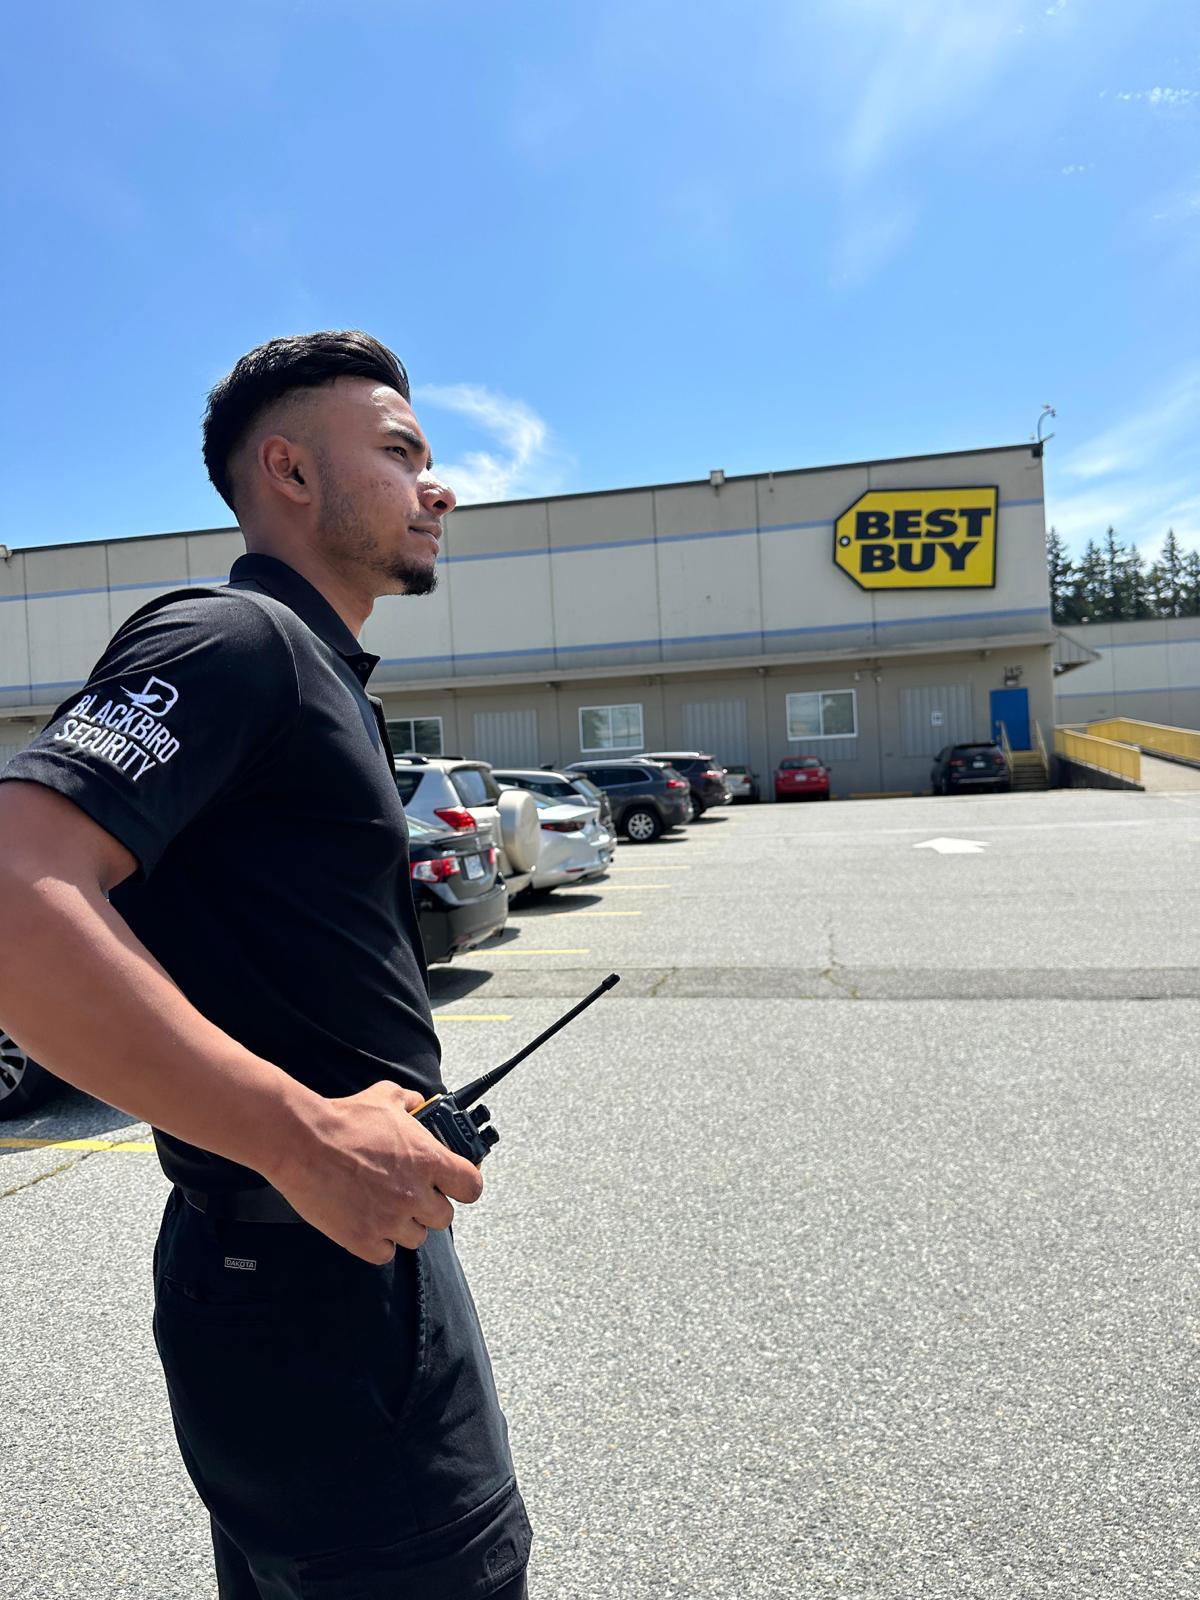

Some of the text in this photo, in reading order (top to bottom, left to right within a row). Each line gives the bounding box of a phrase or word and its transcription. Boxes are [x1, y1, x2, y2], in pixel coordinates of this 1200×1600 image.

[855, 507, 992, 540] BEST
[860, 541, 980, 573] BUY
[68, 694, 180, 764] BLACKBIRD
[54, 718, 156, 782] SECURITY
[226, 1259, 254, 1268] DAKOTA
